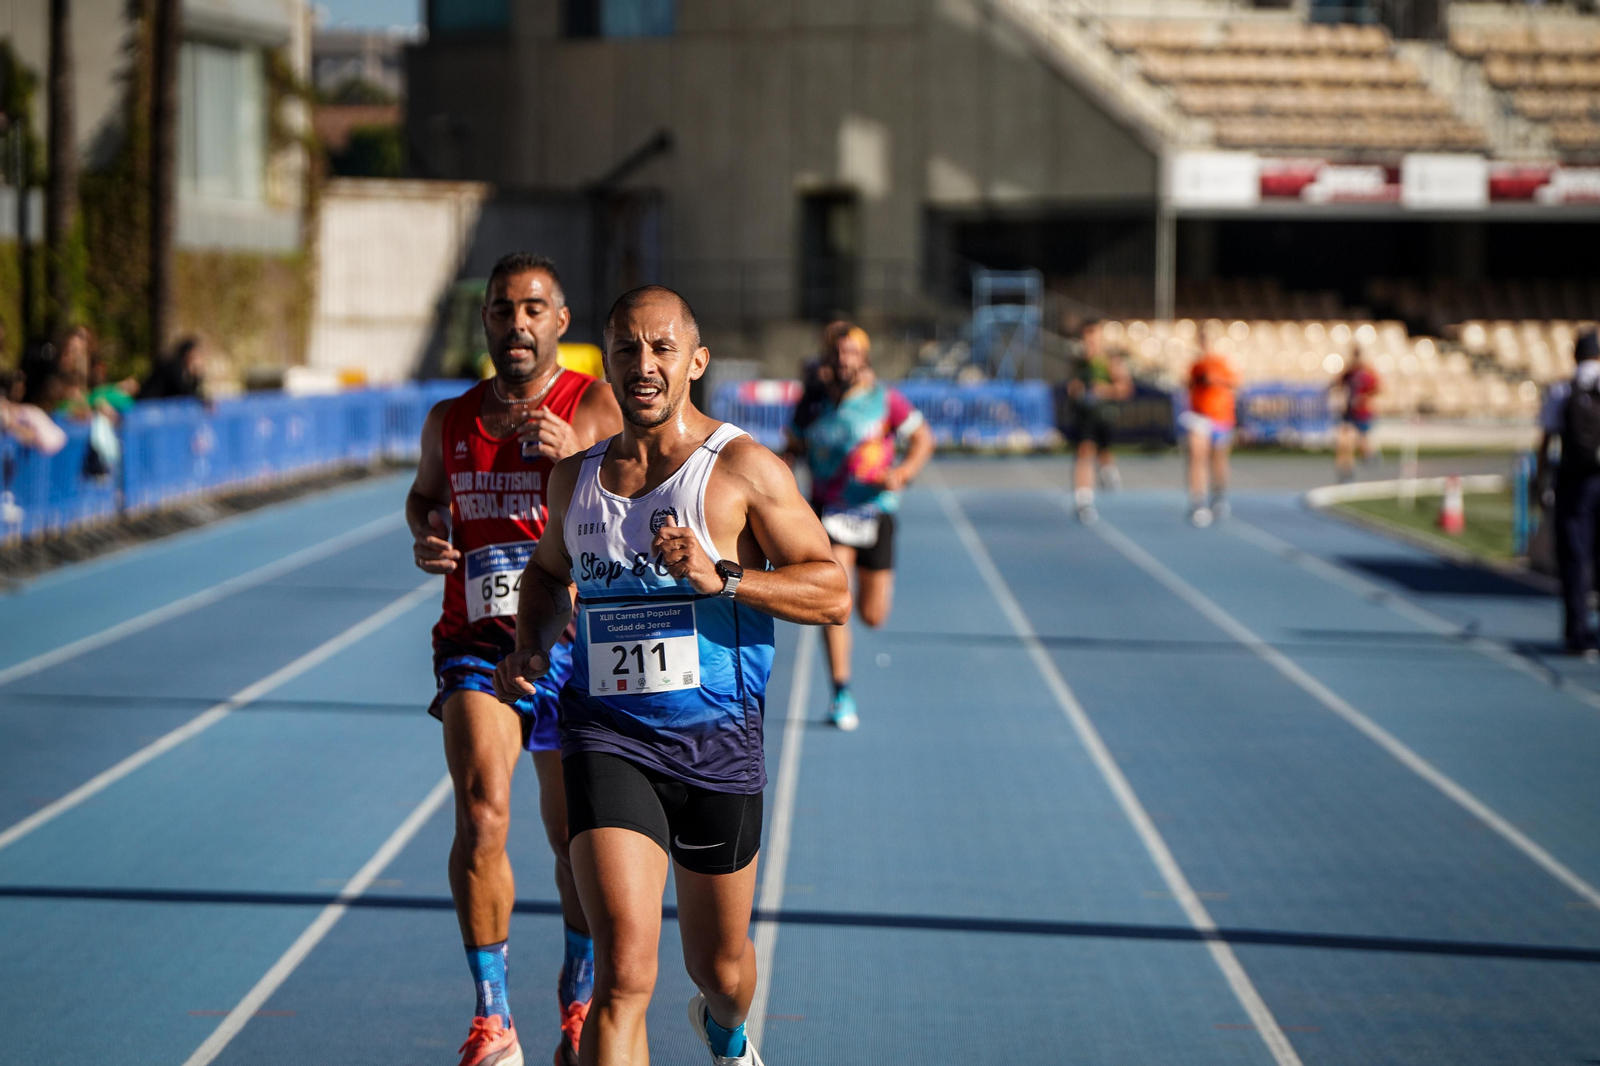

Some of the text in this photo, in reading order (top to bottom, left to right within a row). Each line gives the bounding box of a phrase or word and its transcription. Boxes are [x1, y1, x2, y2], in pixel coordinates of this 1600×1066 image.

[475, 470, 542, 492] ATLETISMO
[456, 491, 545, 522] TREBUJENA
[578, 522, 607, 536] GOBIK
[580, 551, 626, 588] Stop
[631, 552, 650, 577] &
[615, 611, 645, 620] Carrera
[646, 608, 681, 618] Popular
[607, 621, 671, 633] Ciudad de Jerez
[611, 642, 667, 676] 211
